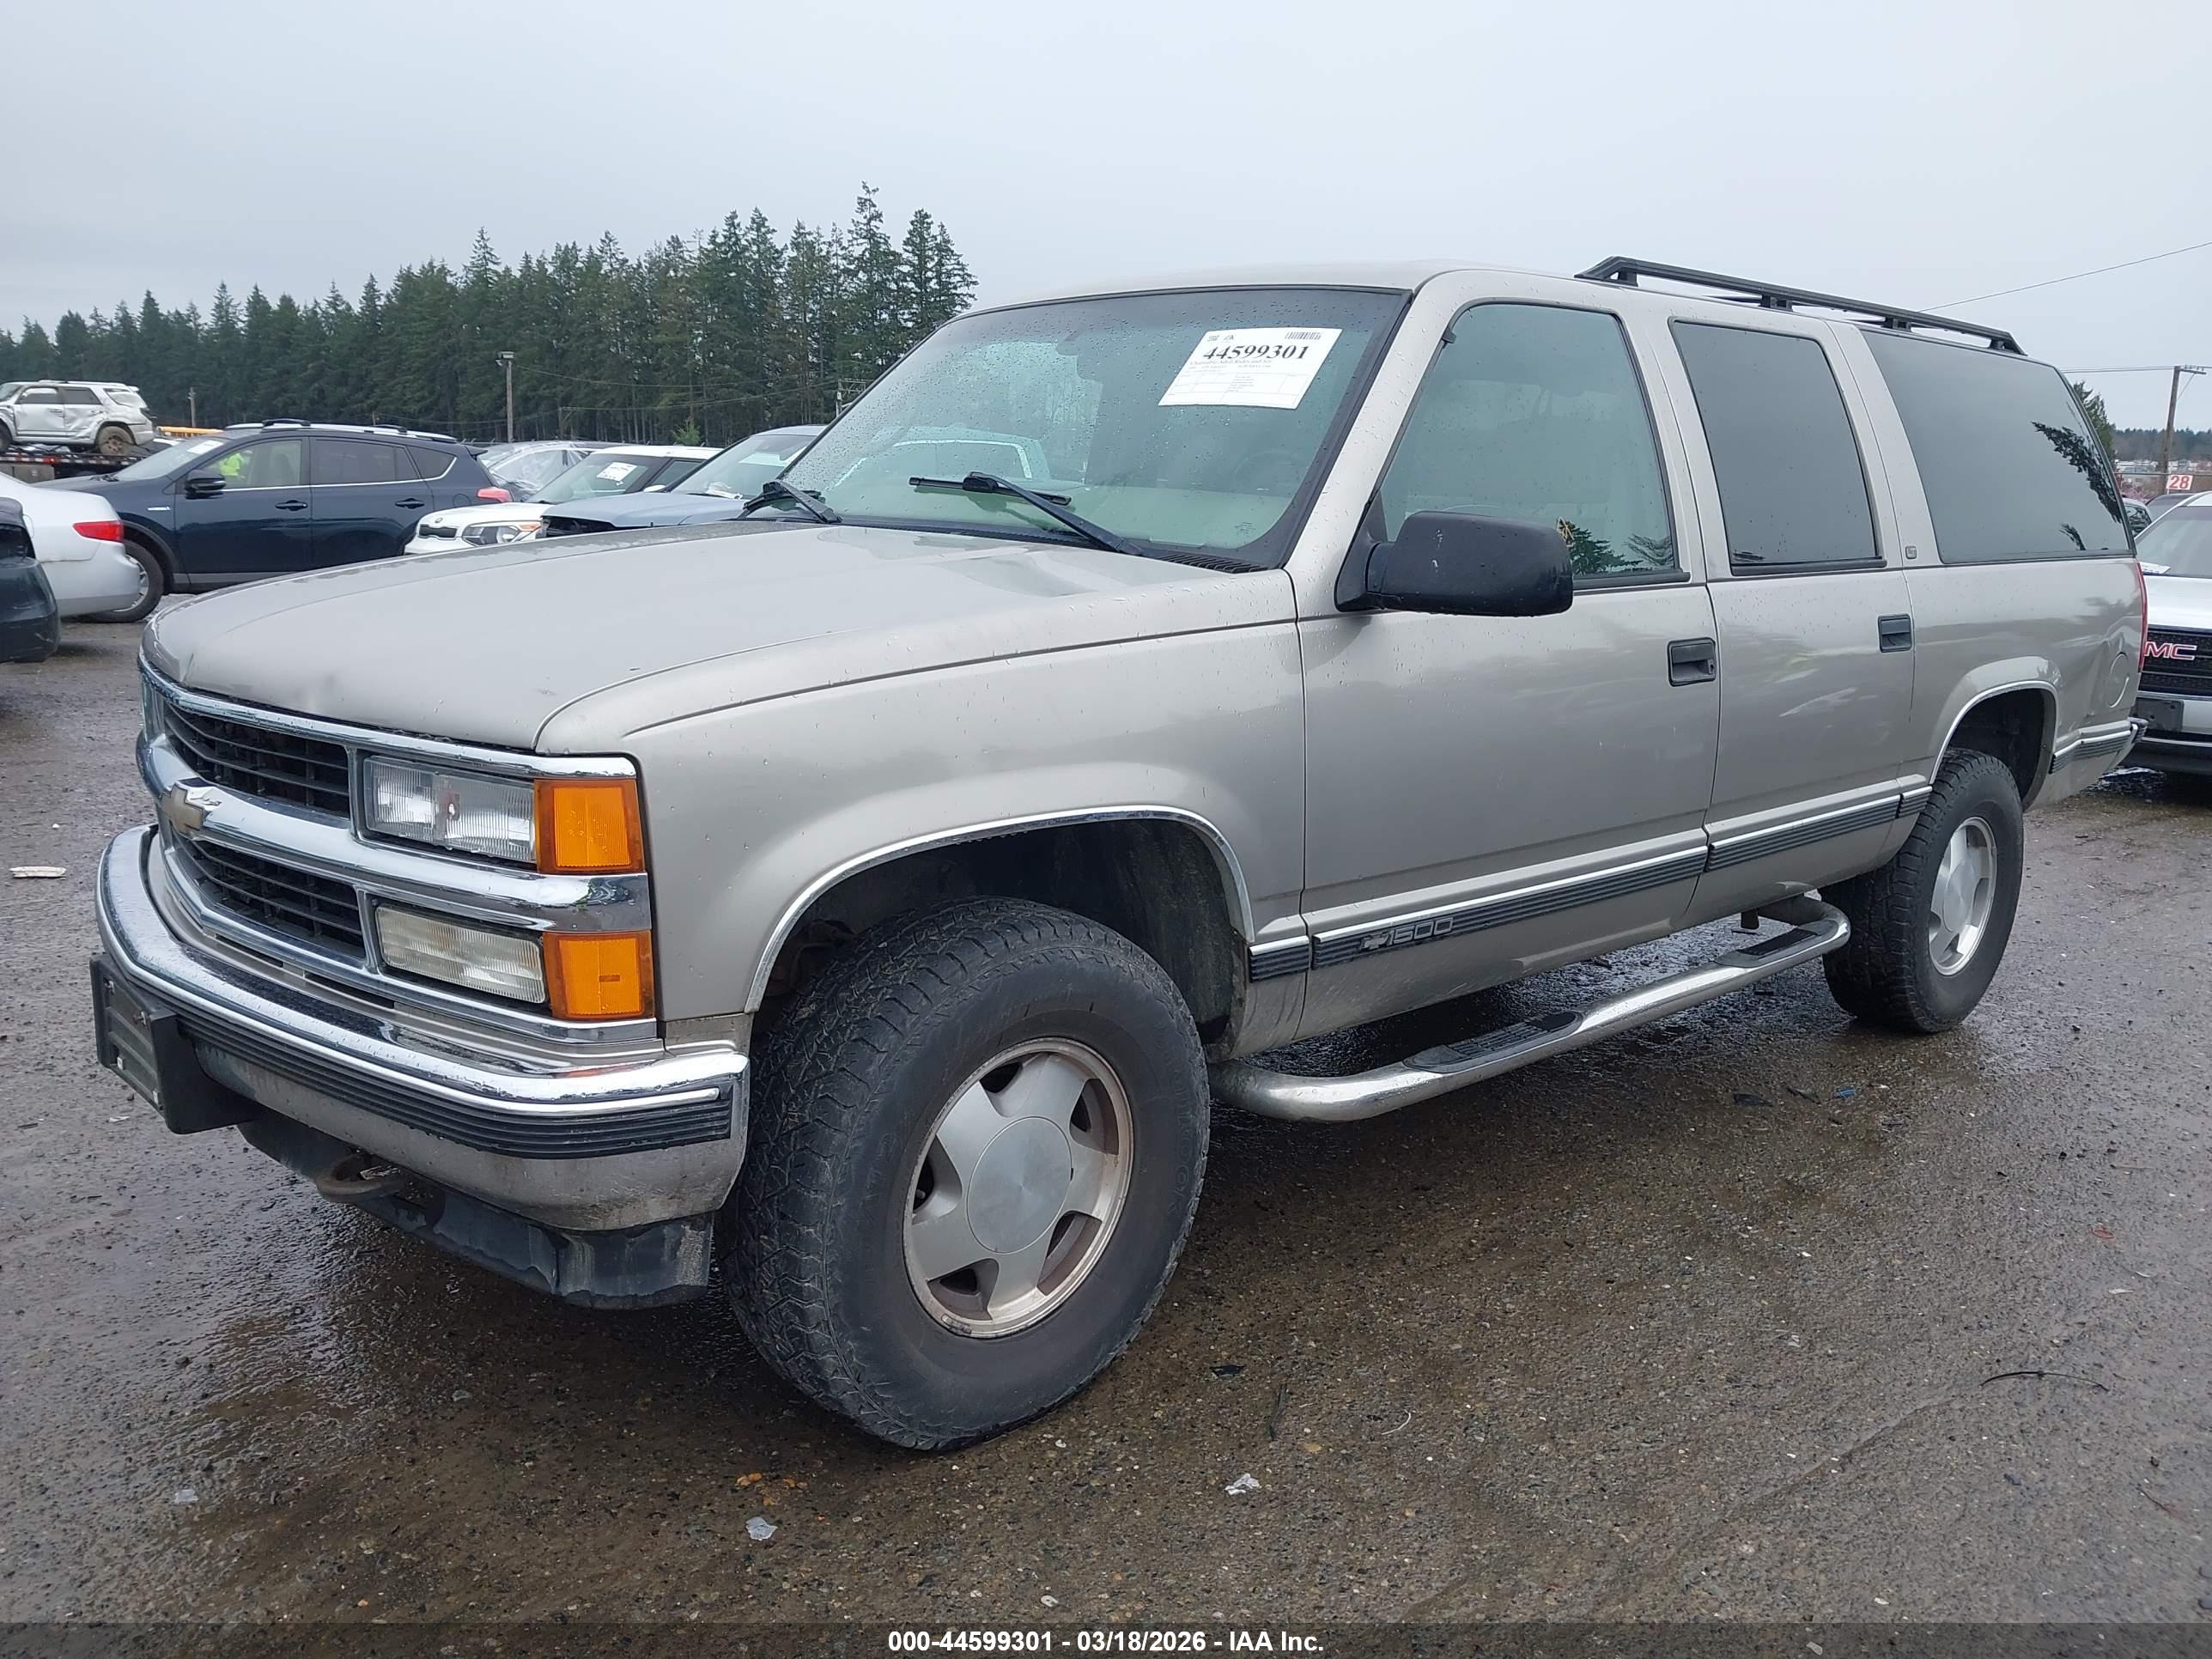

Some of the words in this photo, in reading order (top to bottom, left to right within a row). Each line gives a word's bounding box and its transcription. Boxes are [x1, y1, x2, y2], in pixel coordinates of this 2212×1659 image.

[1203, 344, 1310, 360] 44599301
[2168, 475, 2191, 489] 28
[2144, 641, 2197, 660] MC
[1388, 917, 1454, 945] 1500
